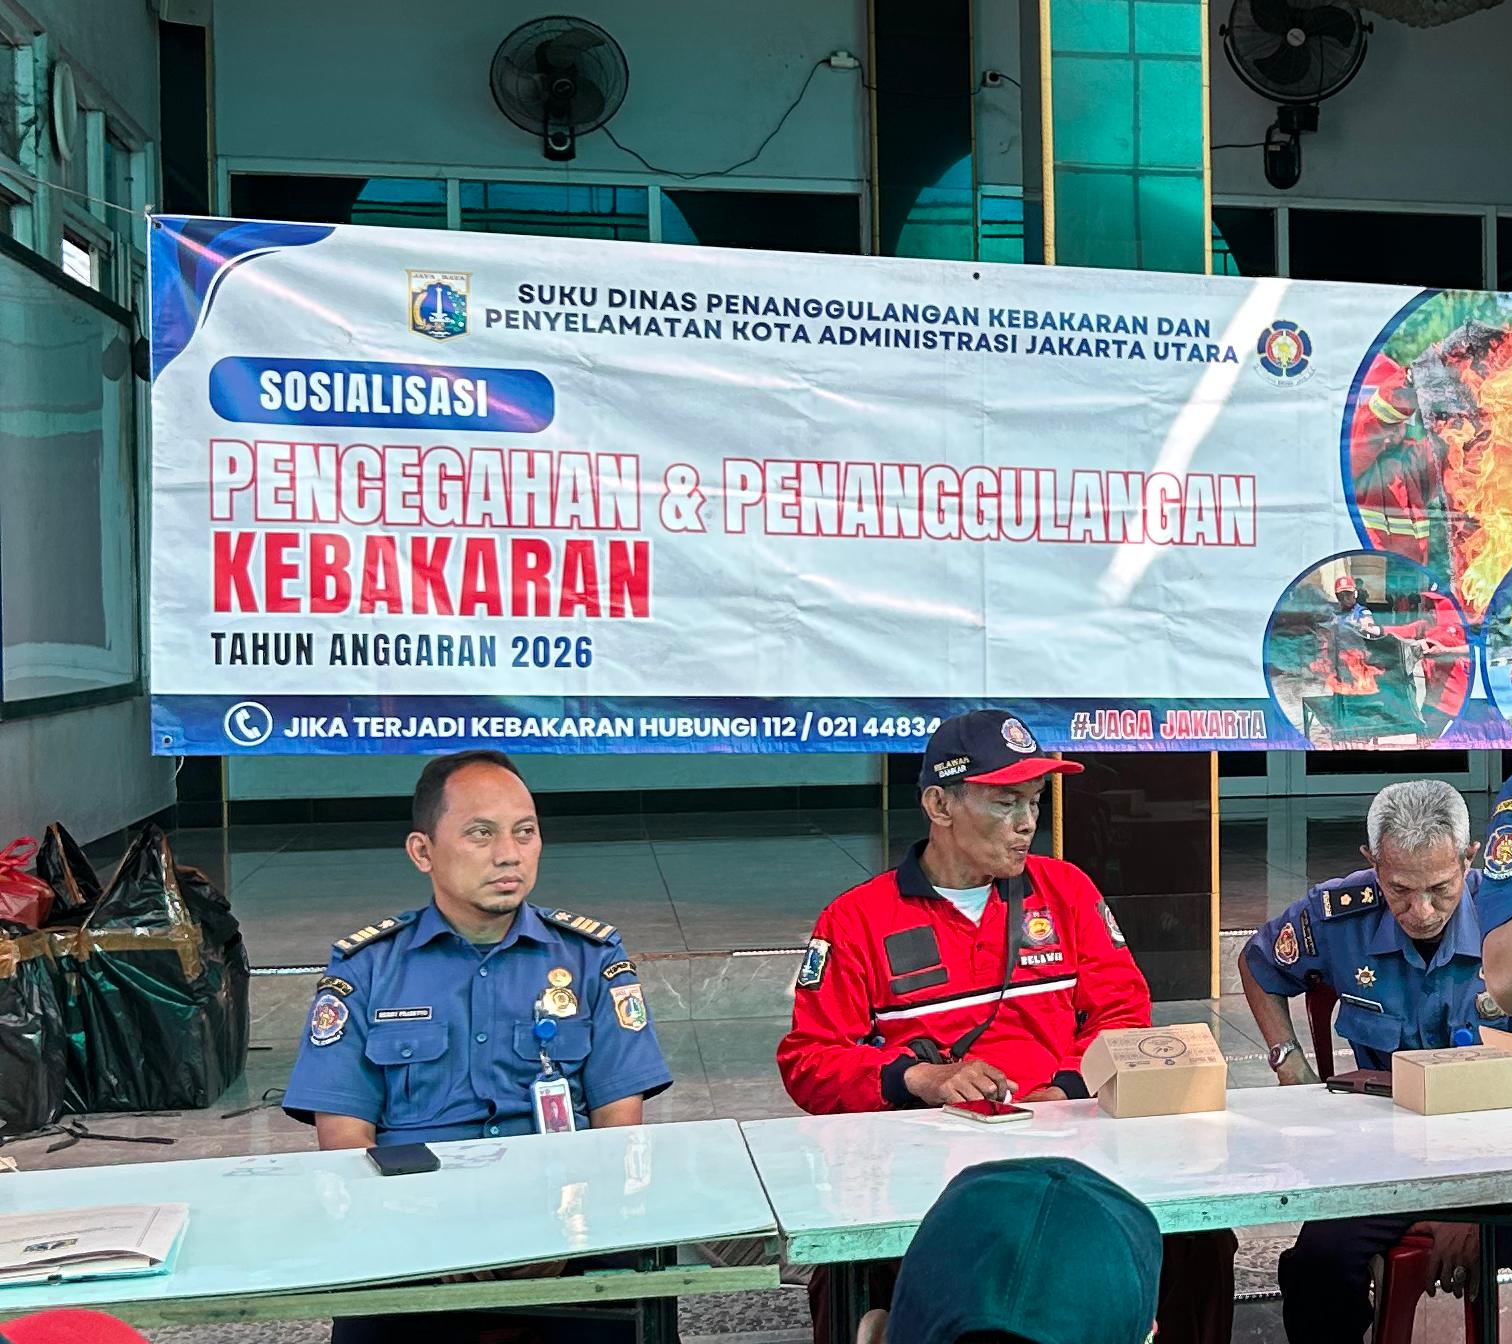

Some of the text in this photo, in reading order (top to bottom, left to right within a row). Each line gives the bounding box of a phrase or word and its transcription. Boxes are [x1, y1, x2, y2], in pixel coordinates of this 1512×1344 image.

[485, 309, 1240, 364] PENYELAMATAN KOTA ADMINISTRASI JAKARTA UTARA
[518, 283, 1211, 338] SUKU DINAS PENANGGULANGAN KEBAKARAN DAN
[260, 370, 488, 419] SOSIALISASI
[208, 438, 1257, 548] PENCEGAHAN & PENANGGULANGAN
[211, 530, 652, 620] KEBAKARAN
[211, 631, 594, 670] TAHUN ANGGARAN 2026
[284, 716, 348, 739] JIKA
[353, 716, 467, 739] TERJADI
[472, 716, 635, 739] KEBAKARAN
[639, 716, 760, 739] HUBUNGI
[763, 716, 797, 739] 112
[800, 715, 813, 743] /
[818, 716, 861, 739] 021
[1070, 710, 1267, 741] #JAGA JAKARTA
